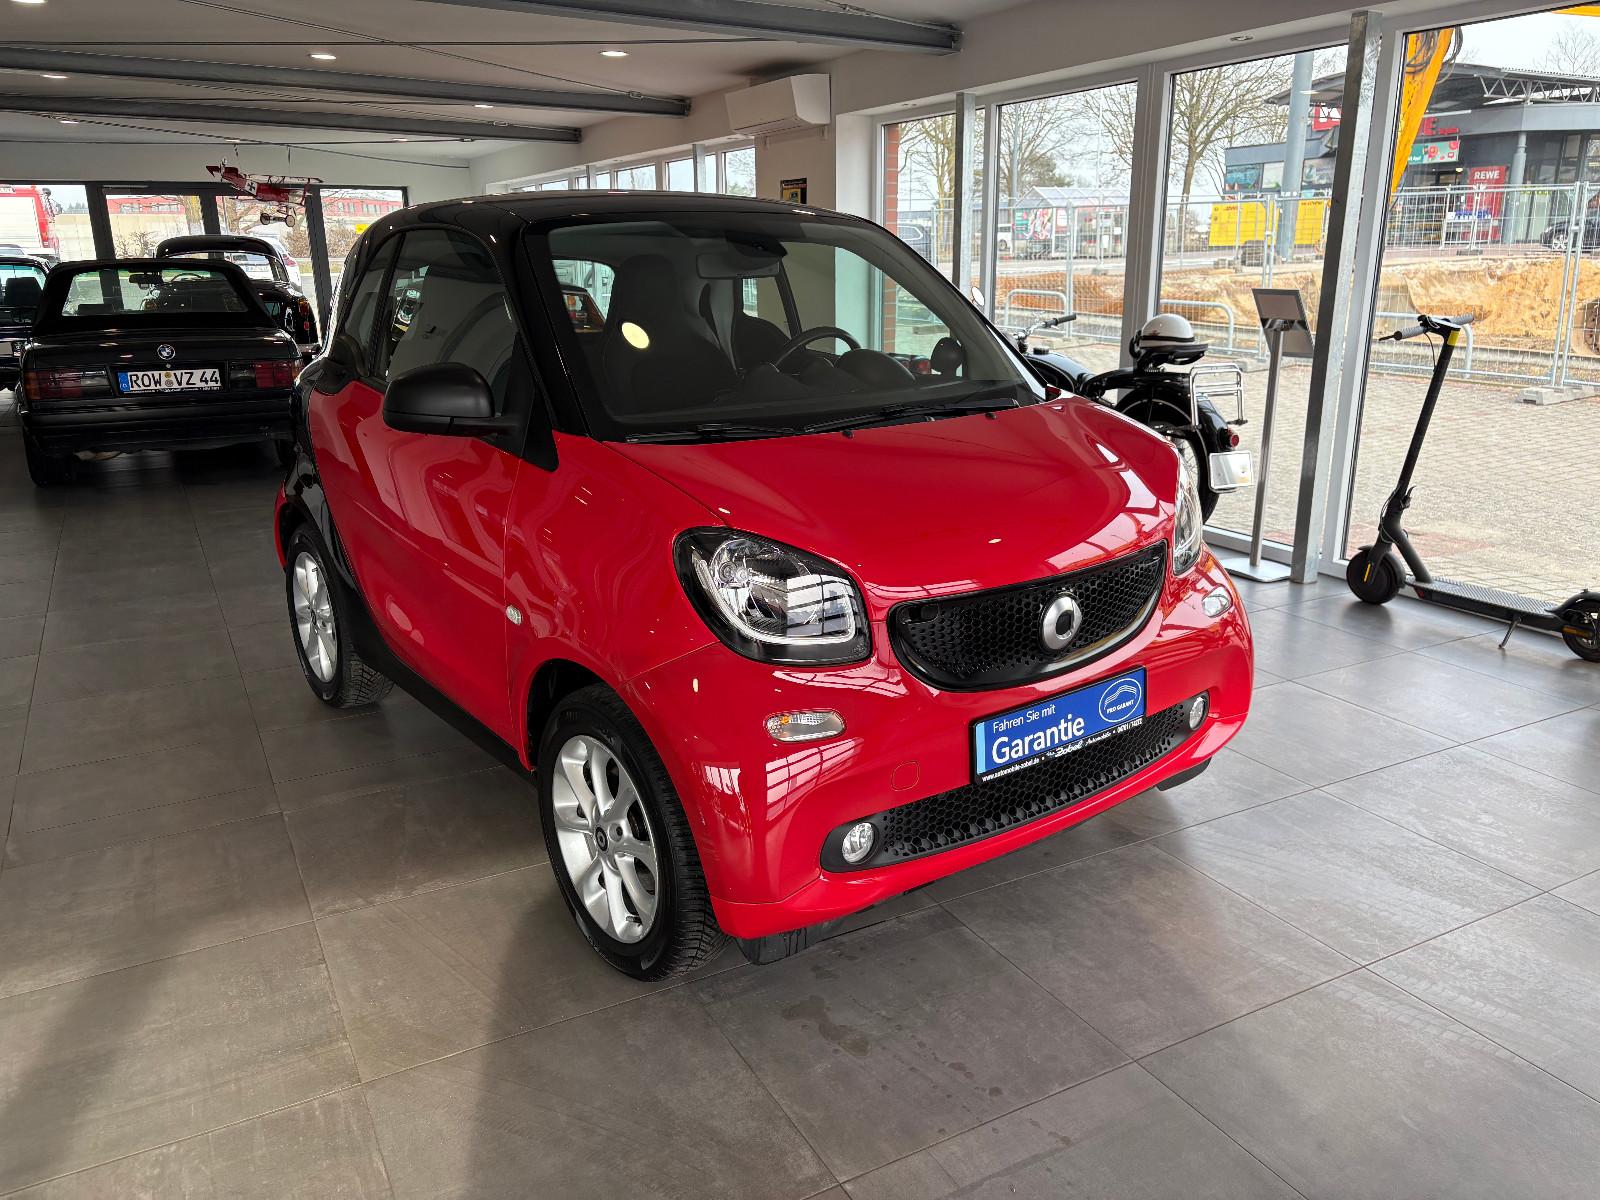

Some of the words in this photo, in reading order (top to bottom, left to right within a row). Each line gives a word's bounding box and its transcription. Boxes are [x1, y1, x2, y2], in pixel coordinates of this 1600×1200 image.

[1474, 170, 1500, 180] REWE
[129, 373, 162, 388] ROW
[173, 371, 197, 386] VZ
[199, 371, 219, 385] 44
[993, 716, 1024, 734] Fahren
[1026, 709, 1040, 723] Sie
[1041, 703, 1056, 717] mit
[1106, 706, 1117, 714] PRO
[992, 713, 1085, 764] Garantie
